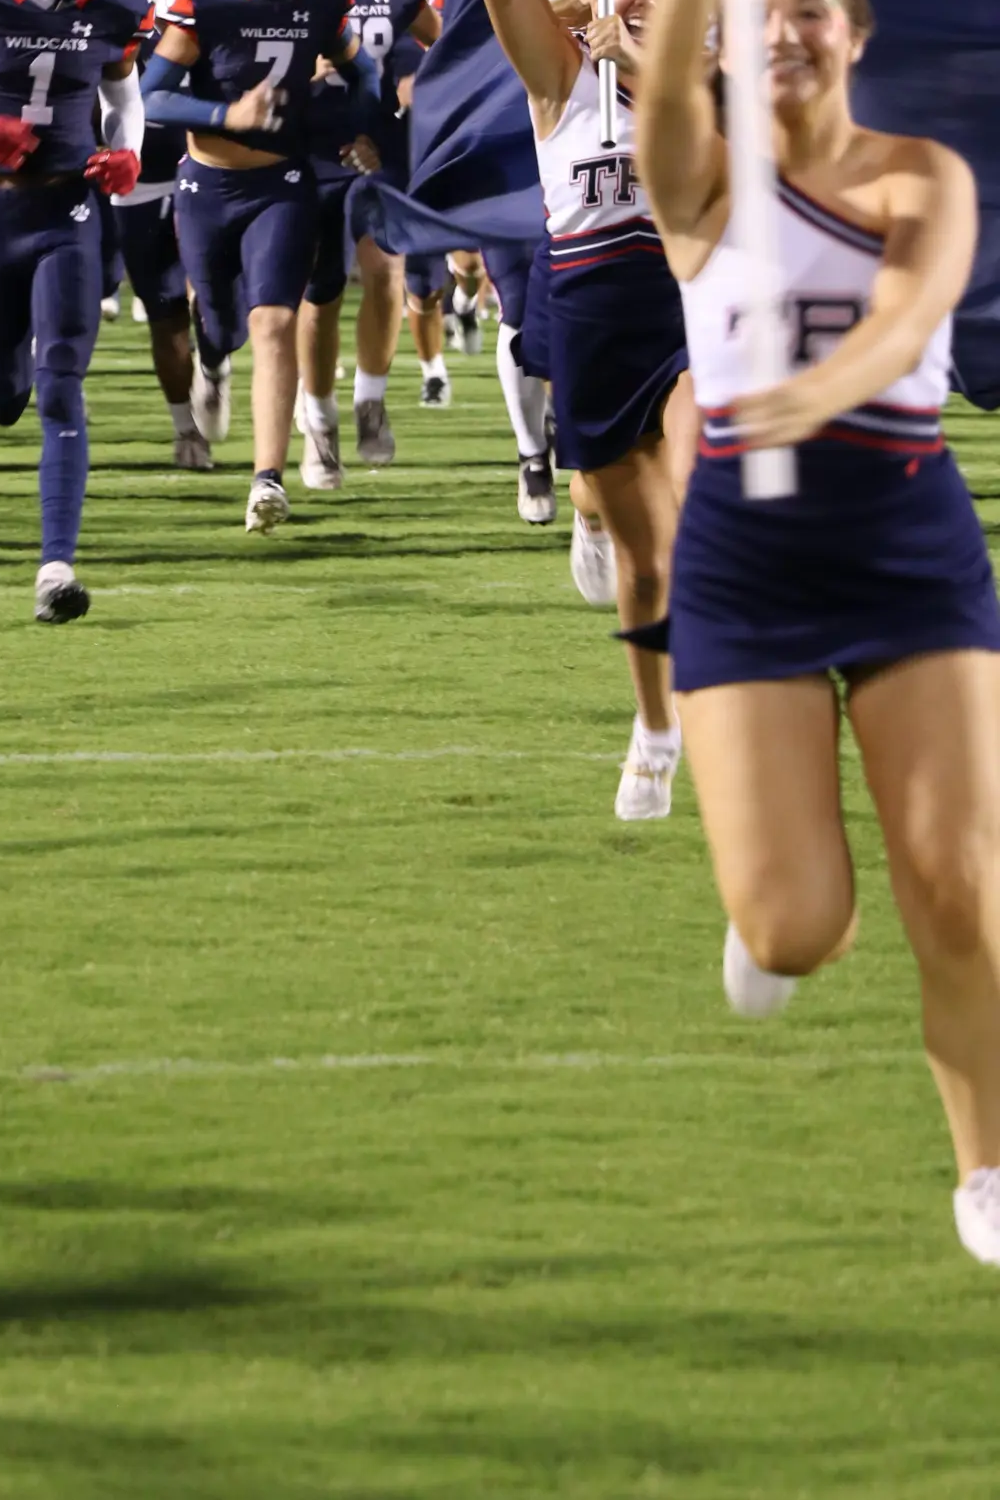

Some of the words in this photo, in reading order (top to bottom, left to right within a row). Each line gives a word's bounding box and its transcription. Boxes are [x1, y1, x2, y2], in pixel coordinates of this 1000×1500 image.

[348, 4, 391, 16] DCATS
[240, 27, 309, 38] WILDCATS
[5, 36, 88, 51] WILDCATS
[254, 40, 294, 88] 7
[21, 51, 57, 125] 1
